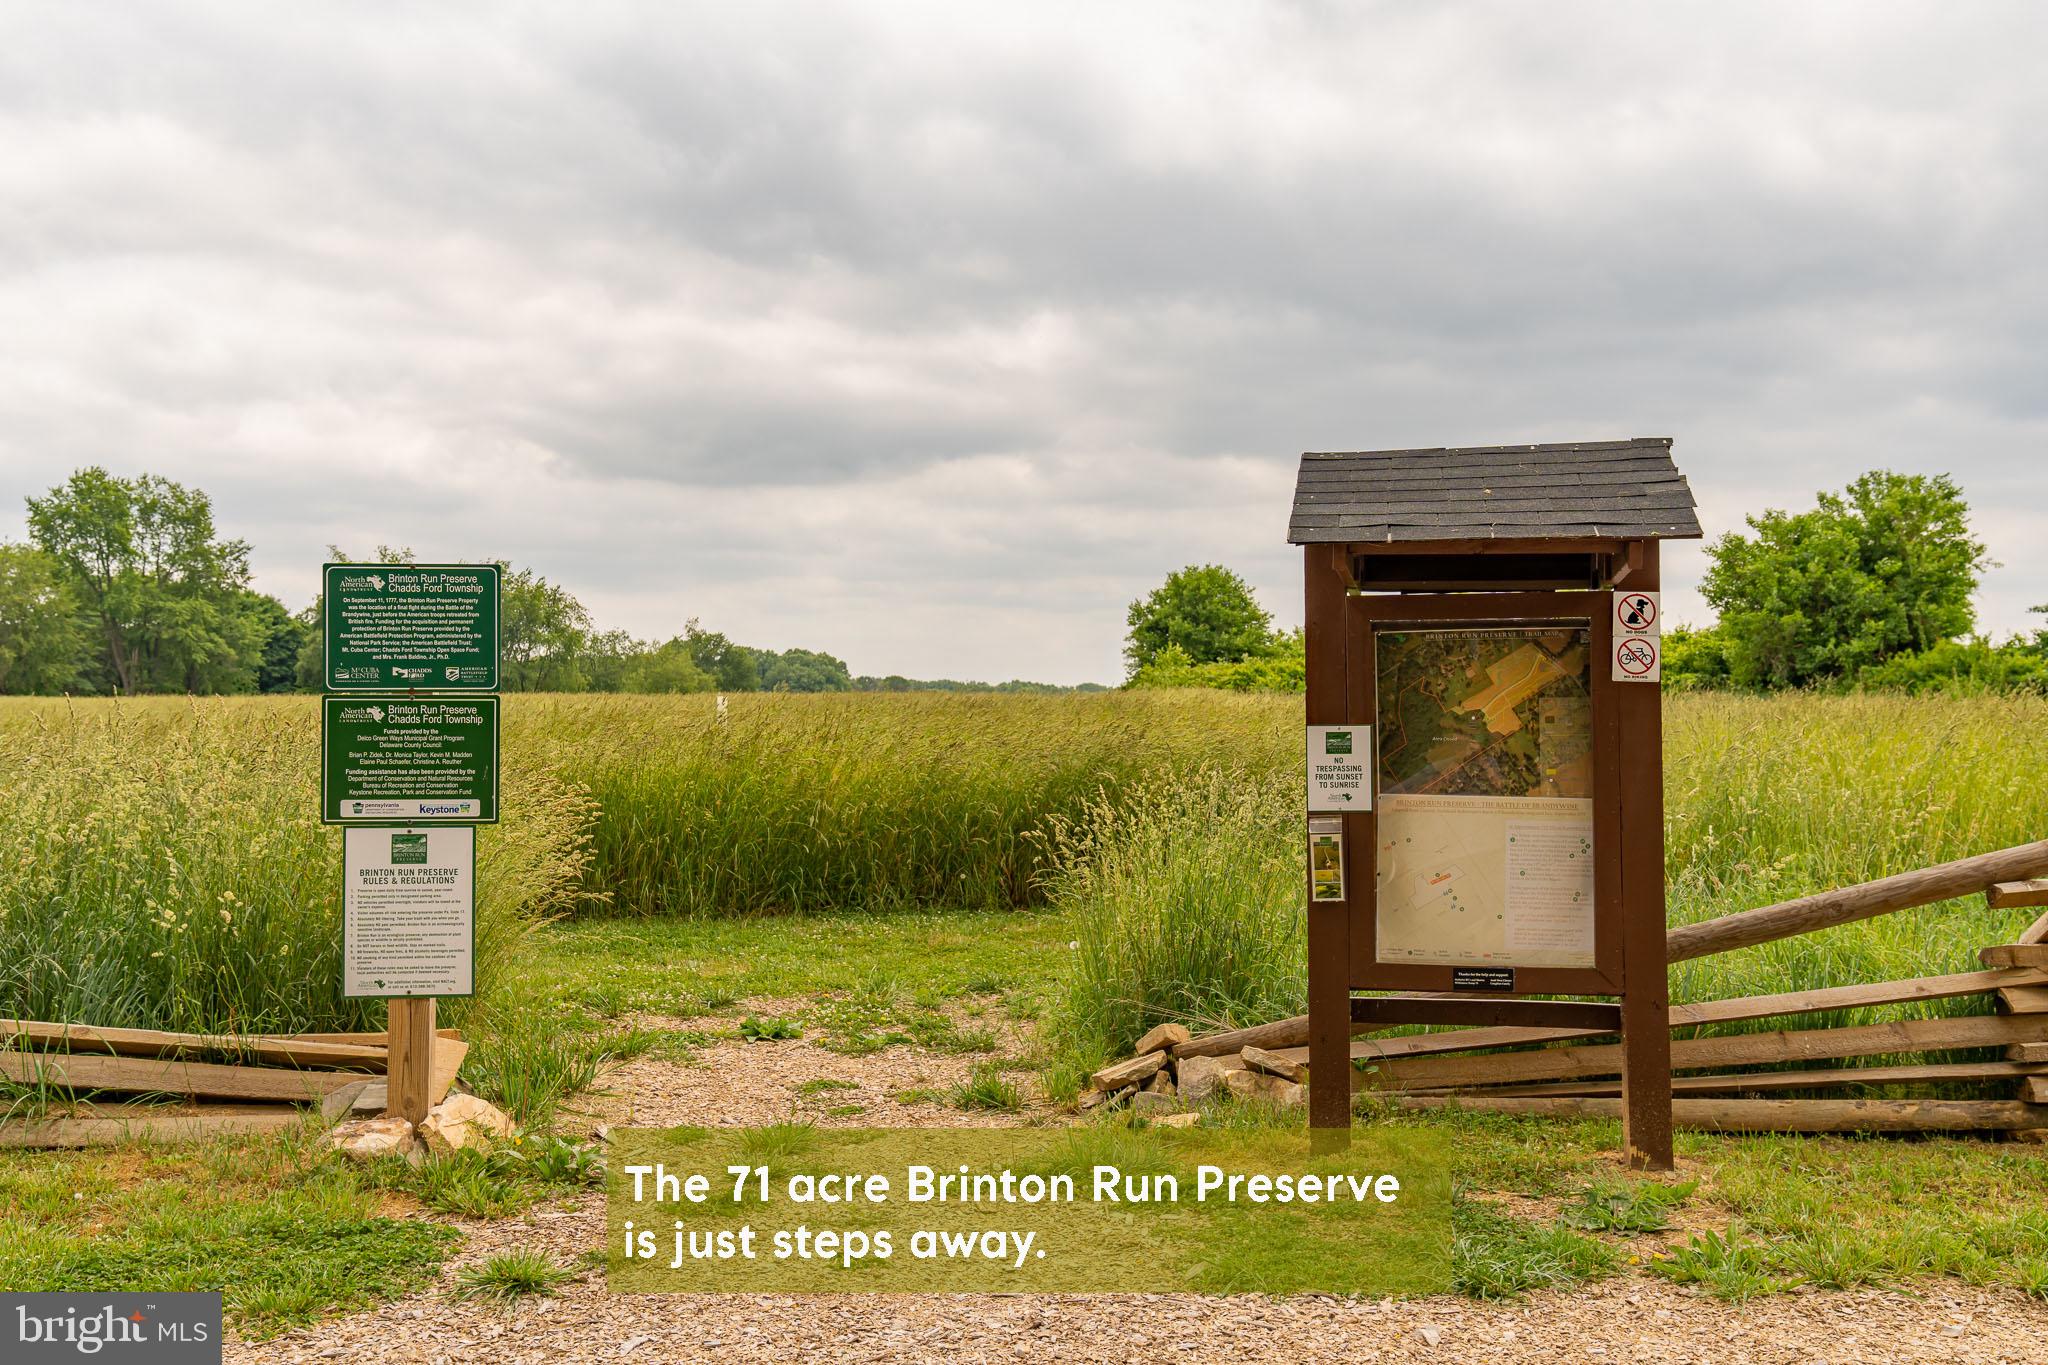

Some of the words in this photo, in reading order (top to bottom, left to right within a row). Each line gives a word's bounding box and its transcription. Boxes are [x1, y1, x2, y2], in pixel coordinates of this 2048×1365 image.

[388, 574, 418, 583] Brinton
[420, 574, 438, 583] Run
[440, 574, 478, 583] Preserve
[388, 583, 421, 592] Chadds
[423, 583, 442, 592] Ford
[445, 583, 484, 594] Township
[388, 705, 418, 714] Brinton
[420, 705, 438, 714] Run
[440, 705, 477, 714] Preserve
[388, 715, 420, 724] Chadds
[423, 715, 442, 724] Ford
[444, 715, 484, 725] Township
[420, 804, 460, 815] Keystone
